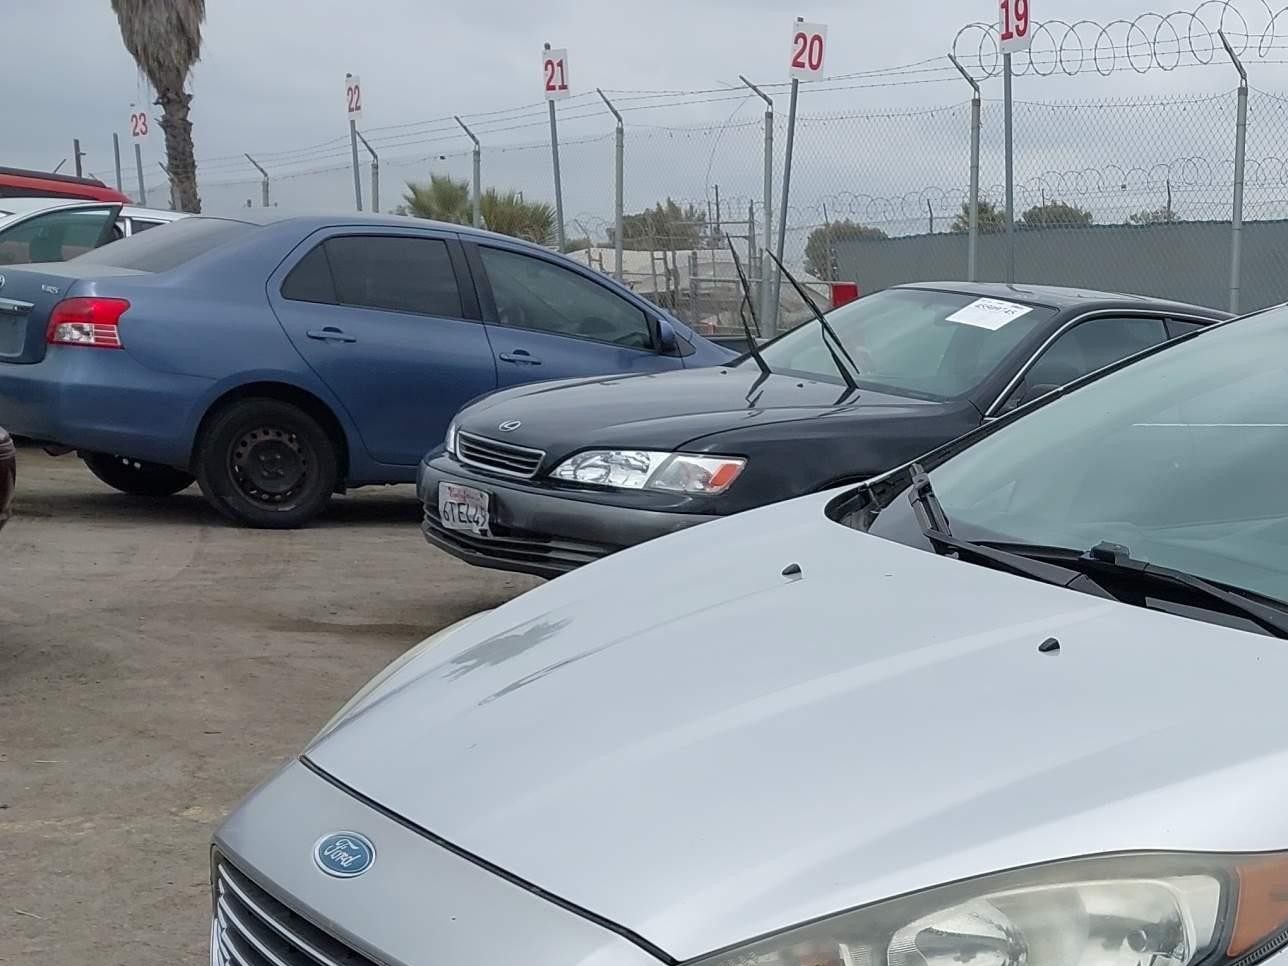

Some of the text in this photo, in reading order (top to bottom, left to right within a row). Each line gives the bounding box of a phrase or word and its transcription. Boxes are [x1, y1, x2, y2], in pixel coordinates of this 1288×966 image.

[1000, 0, 1029, 41] 19
[791, 32, 823, 71] 20
[544, 59, 568, 91] 21
[346, 85, 361, 113] 22
[130, 113, 148, 137] 23
[323, 838, 361, 868] Ford
